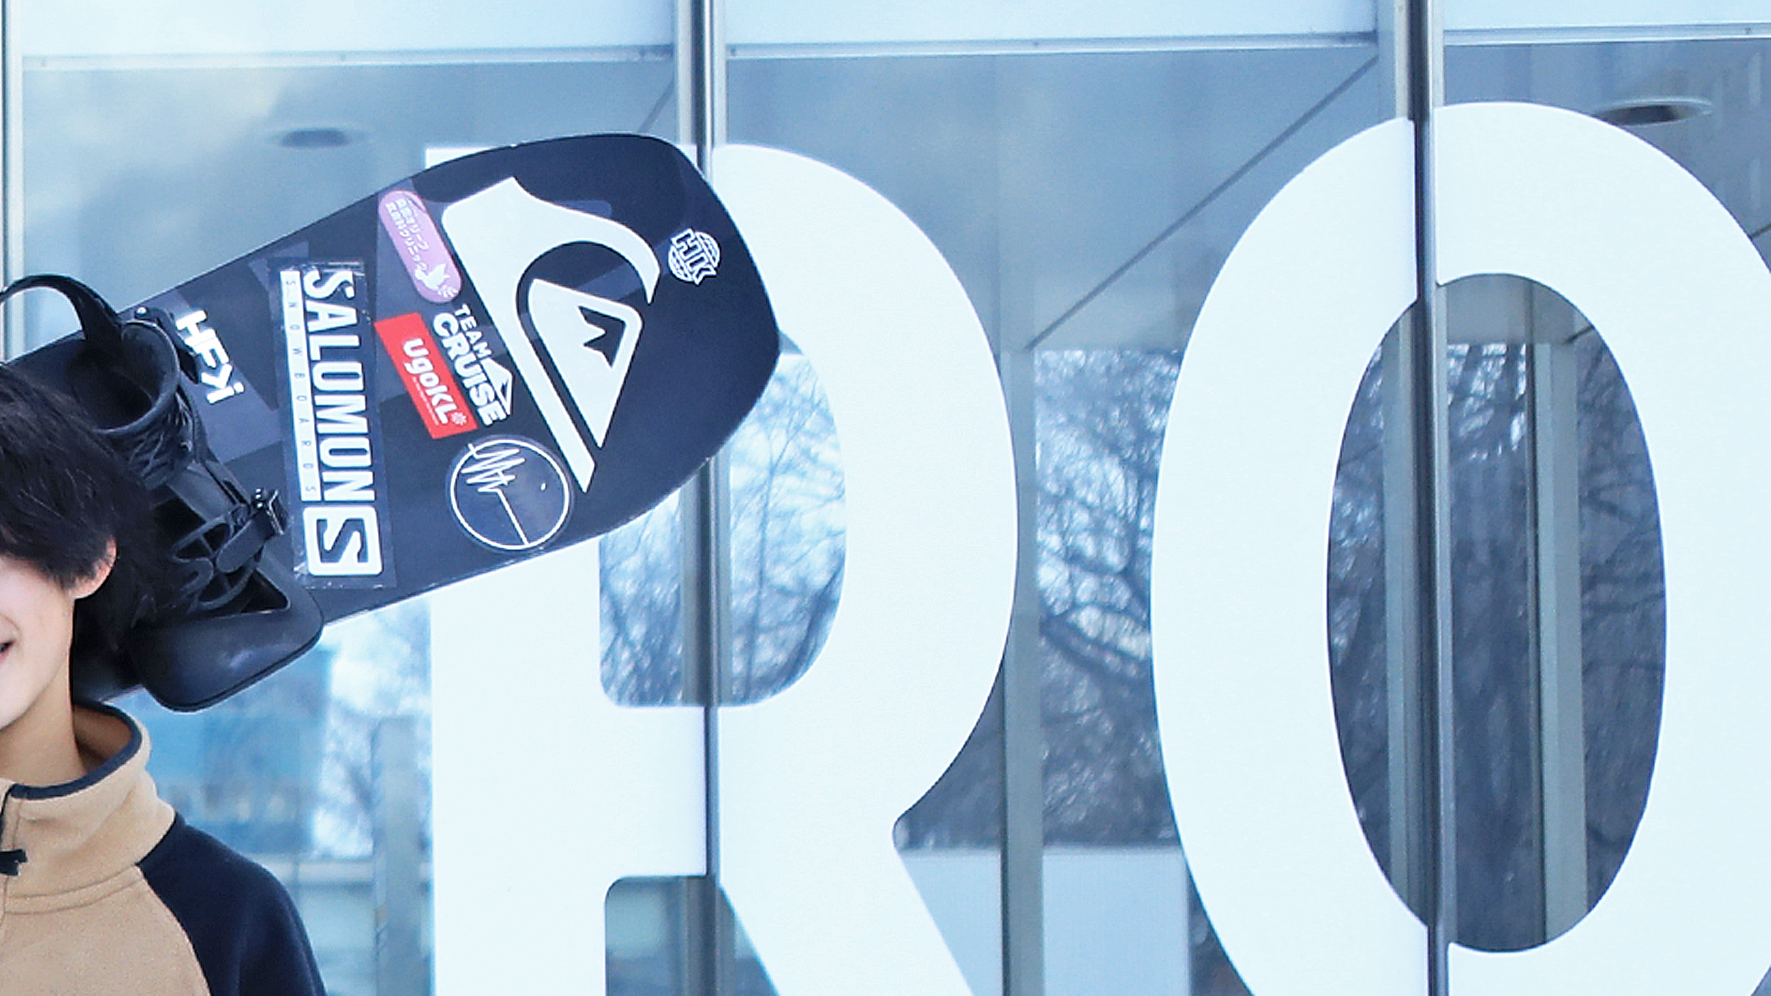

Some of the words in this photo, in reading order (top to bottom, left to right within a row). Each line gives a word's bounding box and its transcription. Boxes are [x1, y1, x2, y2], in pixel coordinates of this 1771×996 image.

[285, 277, 316, 494] SNOWBOARDS
[302, 269, 377, 502] SALOMON
[403, 338, 457, 424] UgoKL
[433, 312, 507, 426] CRUISE
[454, 303, 492, 359] TEAM
